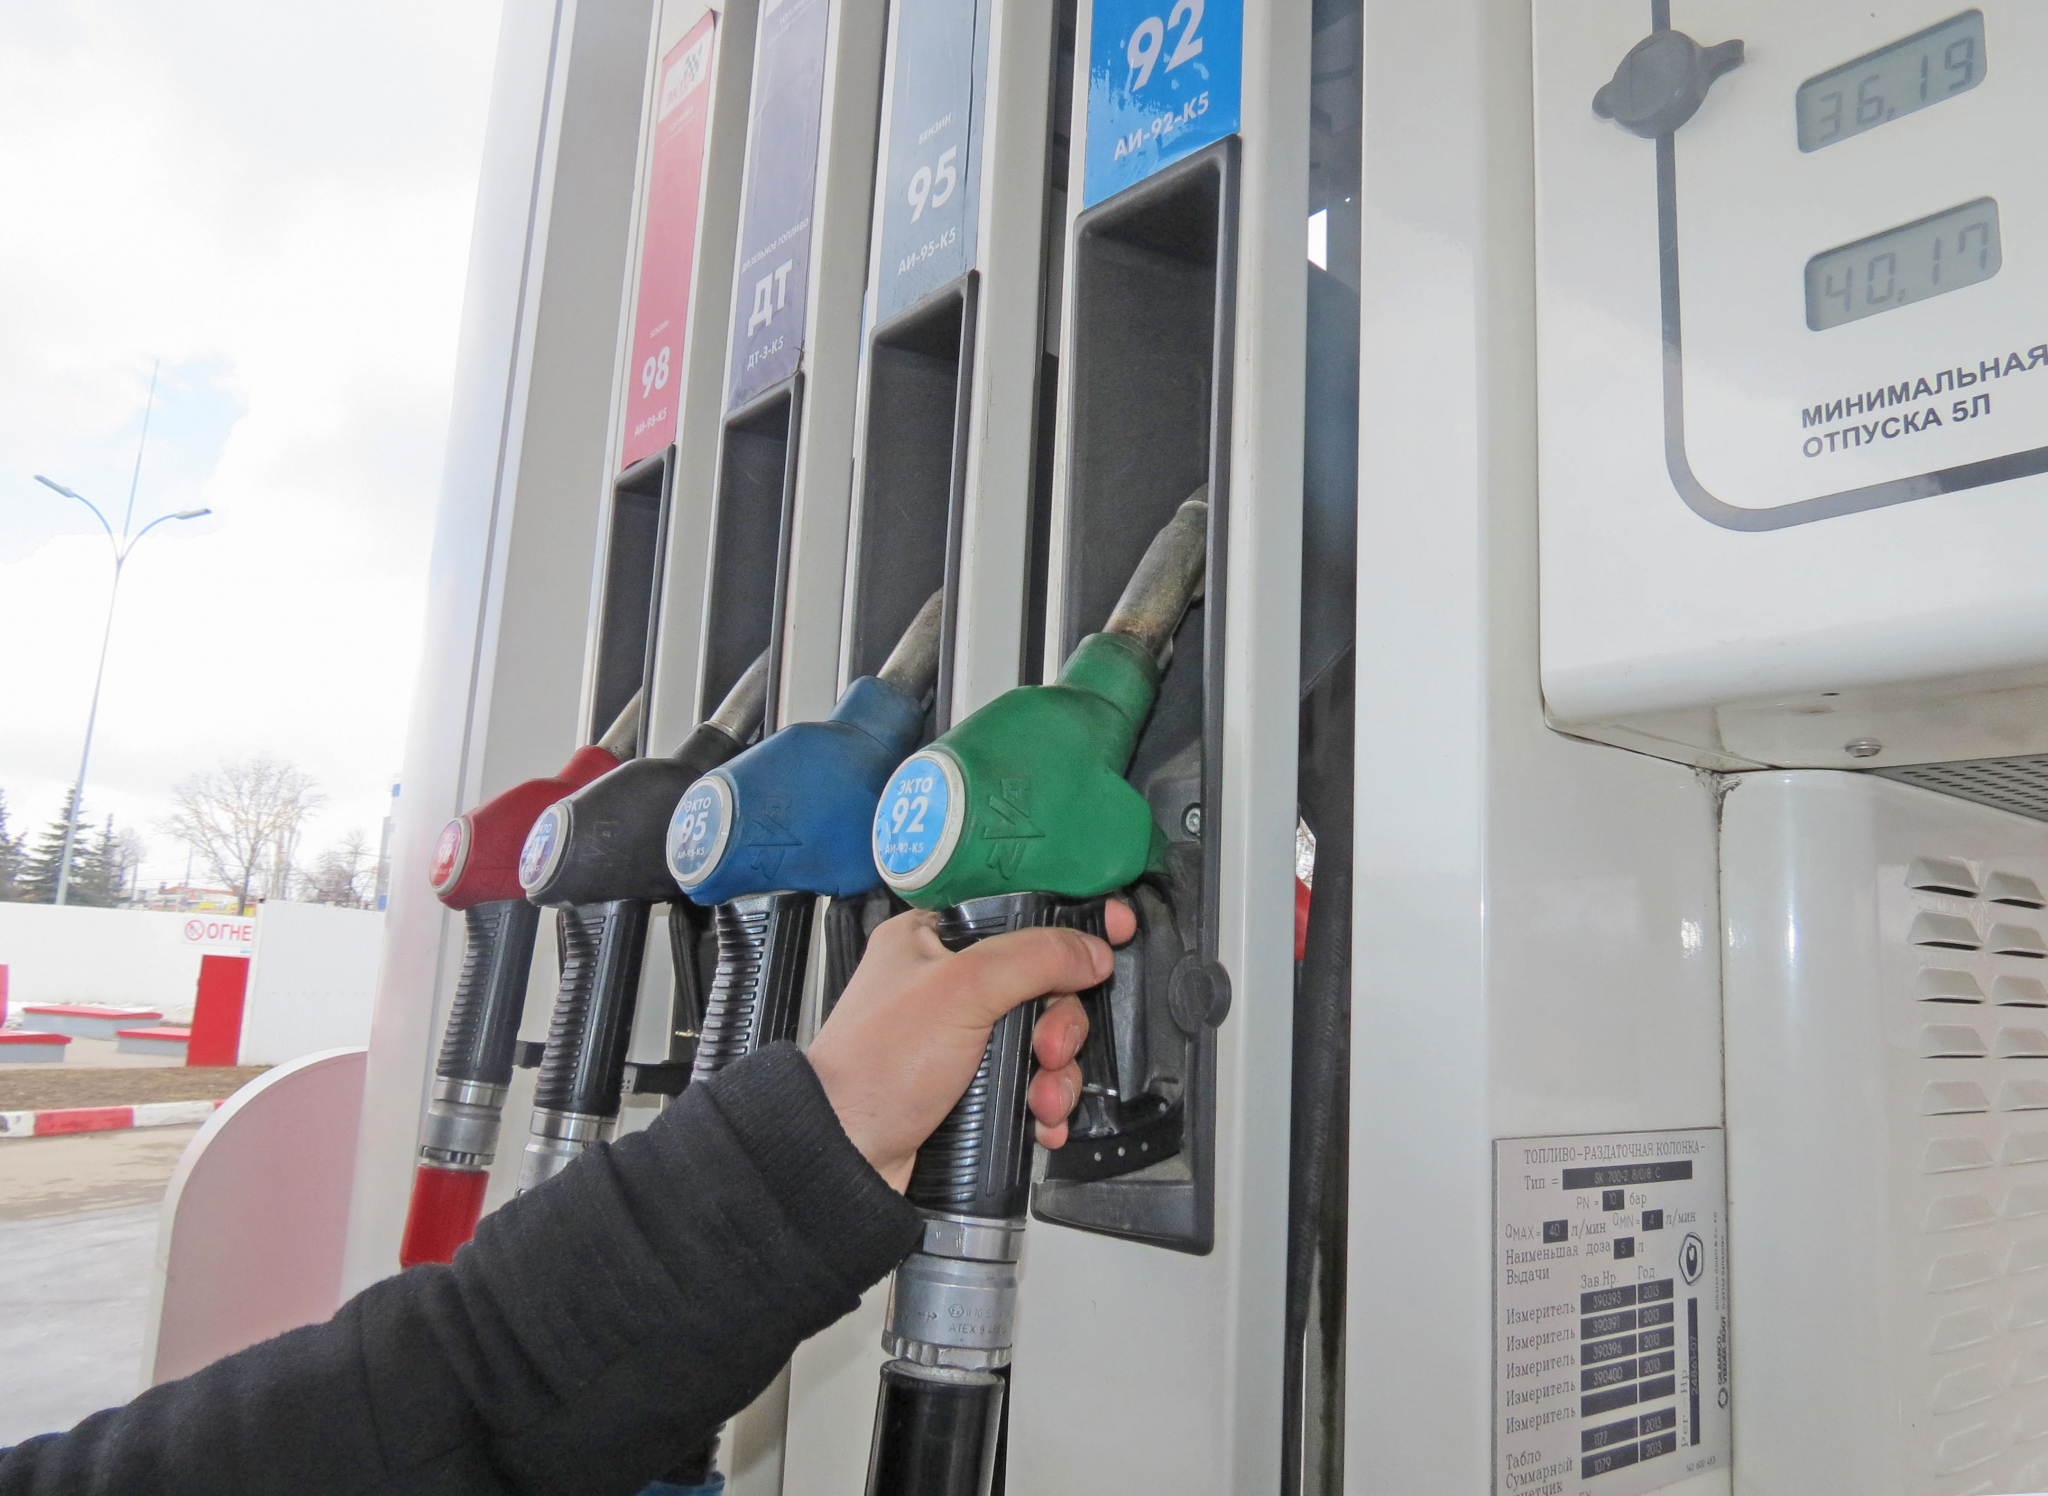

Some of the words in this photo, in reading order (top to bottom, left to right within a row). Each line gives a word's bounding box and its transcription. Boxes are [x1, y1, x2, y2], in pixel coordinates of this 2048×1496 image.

[1127, 0, 1205, 91] 92
[919, 112, 951, 145] БЕНЗИН
[1114, 91, 1209, 160] АИ-92-К5
[907, 145, 957, 225] 95
[898, 227, 956, 276] АИ-95-К5
[747, 259, 793, 338] ДТ
[642, 346, 670, 399] 98
[1802, 343, 2048, 428] МИНИМАЛЬНАЯ
[1802, 407, 1943, 458] ОТПУСКА
[1952, 393, 1992, 423] 5Л
[897, 777, 933, 796] ЭКТО
[684, 796, 711, 814] ЭКТО
[891, 796, 928, 834] 92
[682, 811, 708, 843] 95
[884, 843, 924, 855] АИ-92-К5
[206, 923, 252, 941] ОГНЕ
[1524, 1175, 1545, 1191] Тип
[1576, 1197, 1590, 1210] PN
[1629, 1193, 1647, 1209] бар
[1549, 1224, 1560, 1237] 40
[1571, 1218, 1606, 1240] л/мин
[1665, 1208, 1696, 1229] л/мин
[1506, 1244, 1579, 1266] Наименьшая
[1586, 1240, 1611, 1256] доза
[1506, 1268, 1550, 1286] Выдачи
[1506, 1303, 1576, 1325] Измеритель
[1644, 1284, 1660, 1299] 2013
[948, 1323, 976, 1335] ATEX
[1506, 1328, 1576, 1352] Измеритель
[1644, 1309, 1660, 1323] 2013
[1506, 1353, 1576, 1380] Измеритель
[1644, 1333, 1660, 1348] 2013
[1506, 1380, 1576, 1407] Измеритель
[1644, 1358, 1660, 1374] 2013
[1506, 1405, 1576, 1434] Измеритель
[1506, 1450, 1541, 1471] Табло
[1645, 1416, 1662, 1432] 2013
[1645, 1441, 1662, 1457] 2013
